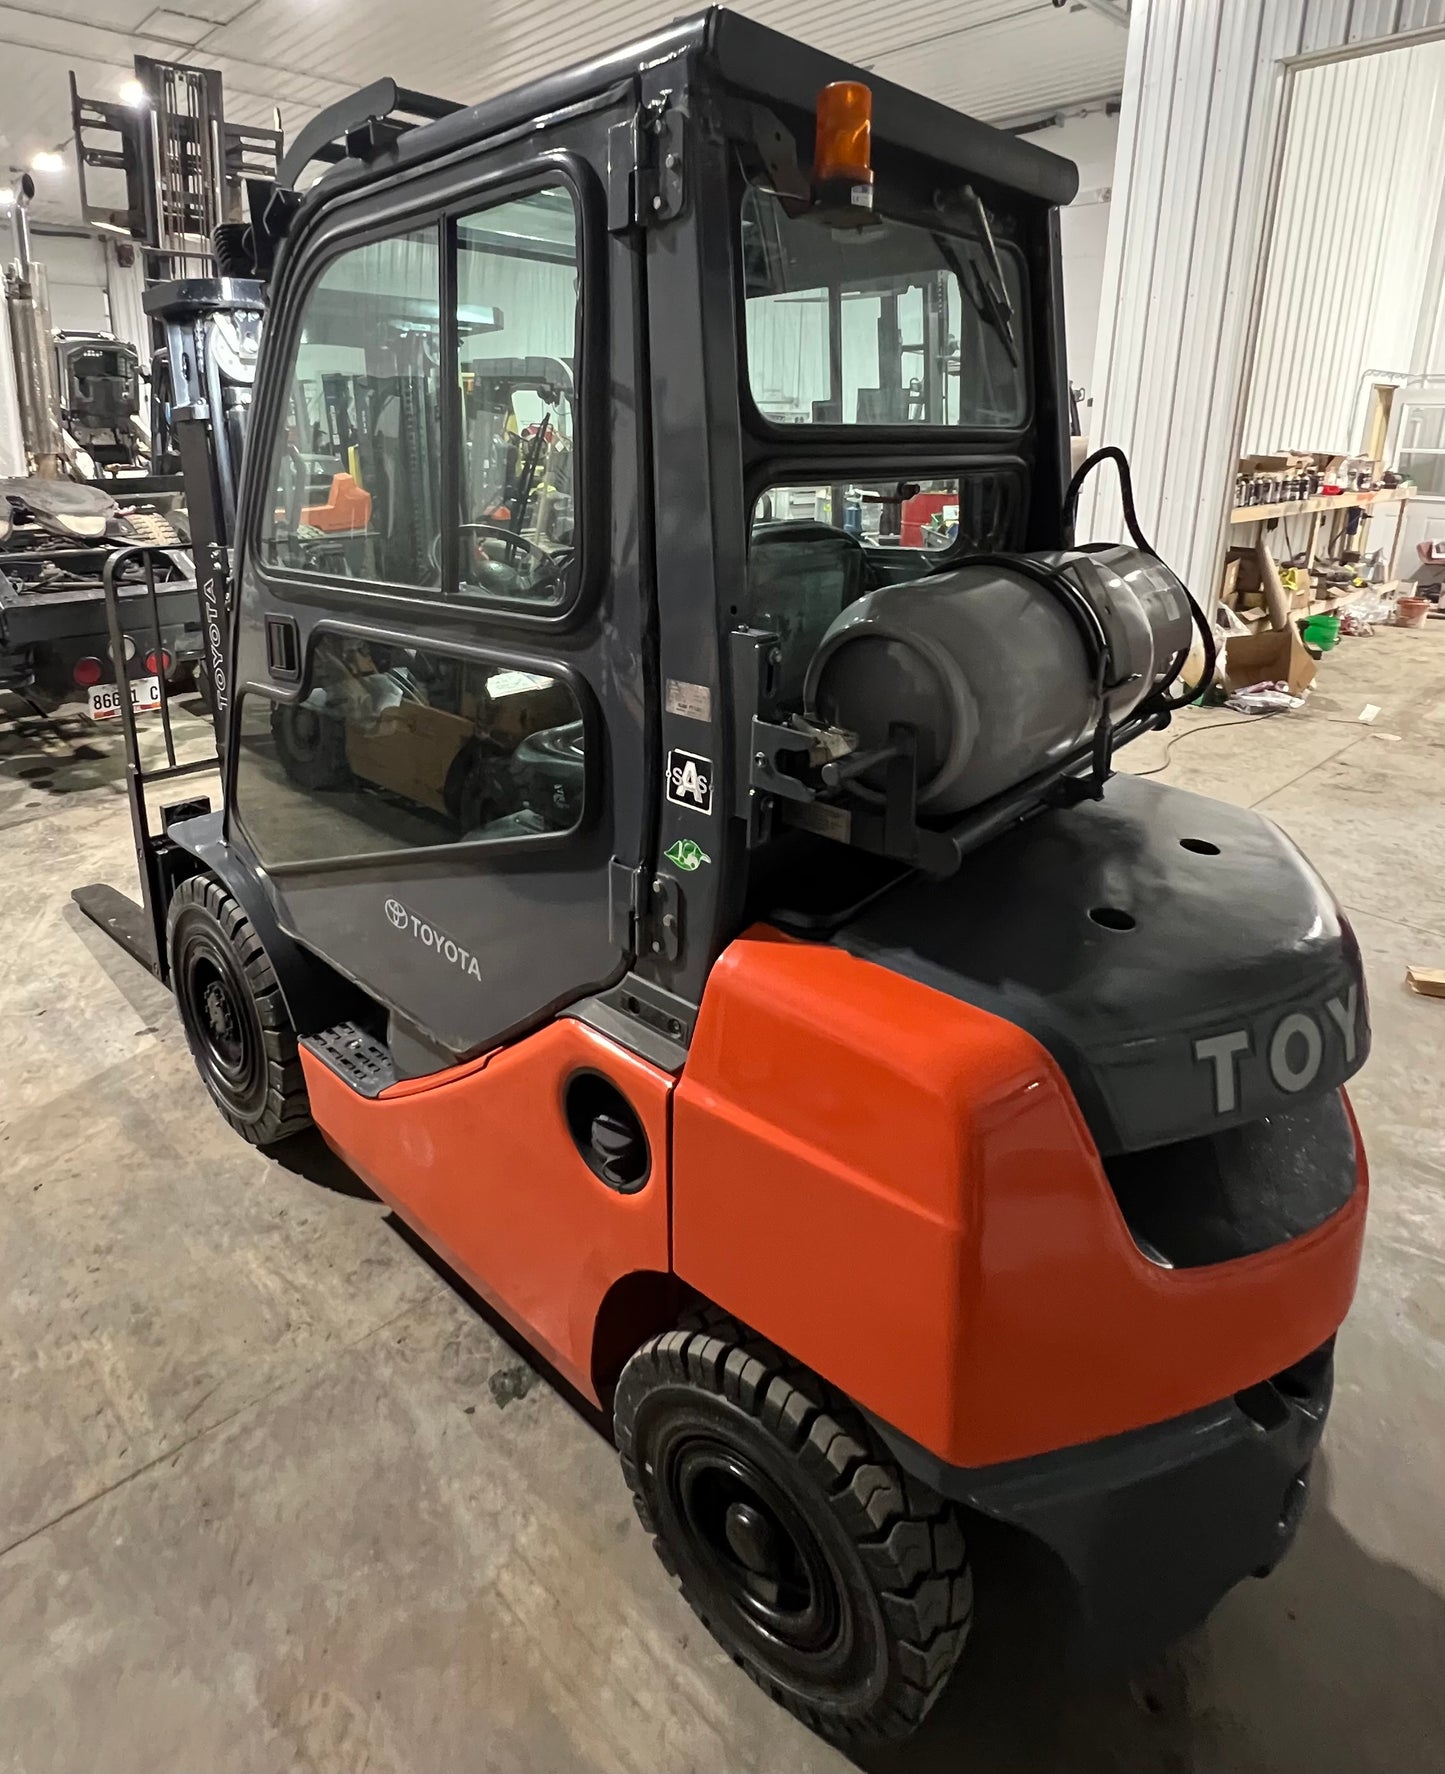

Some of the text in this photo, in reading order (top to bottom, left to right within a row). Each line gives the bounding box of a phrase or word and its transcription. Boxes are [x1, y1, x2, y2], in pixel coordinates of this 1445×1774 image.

[203, 578, 228, 711] TOYOTA
[93, 686, 158, 710] 8661 C
[410, 914, 482, 982] TOYOTA
[1195, 983, 1358, 1113] TOY
